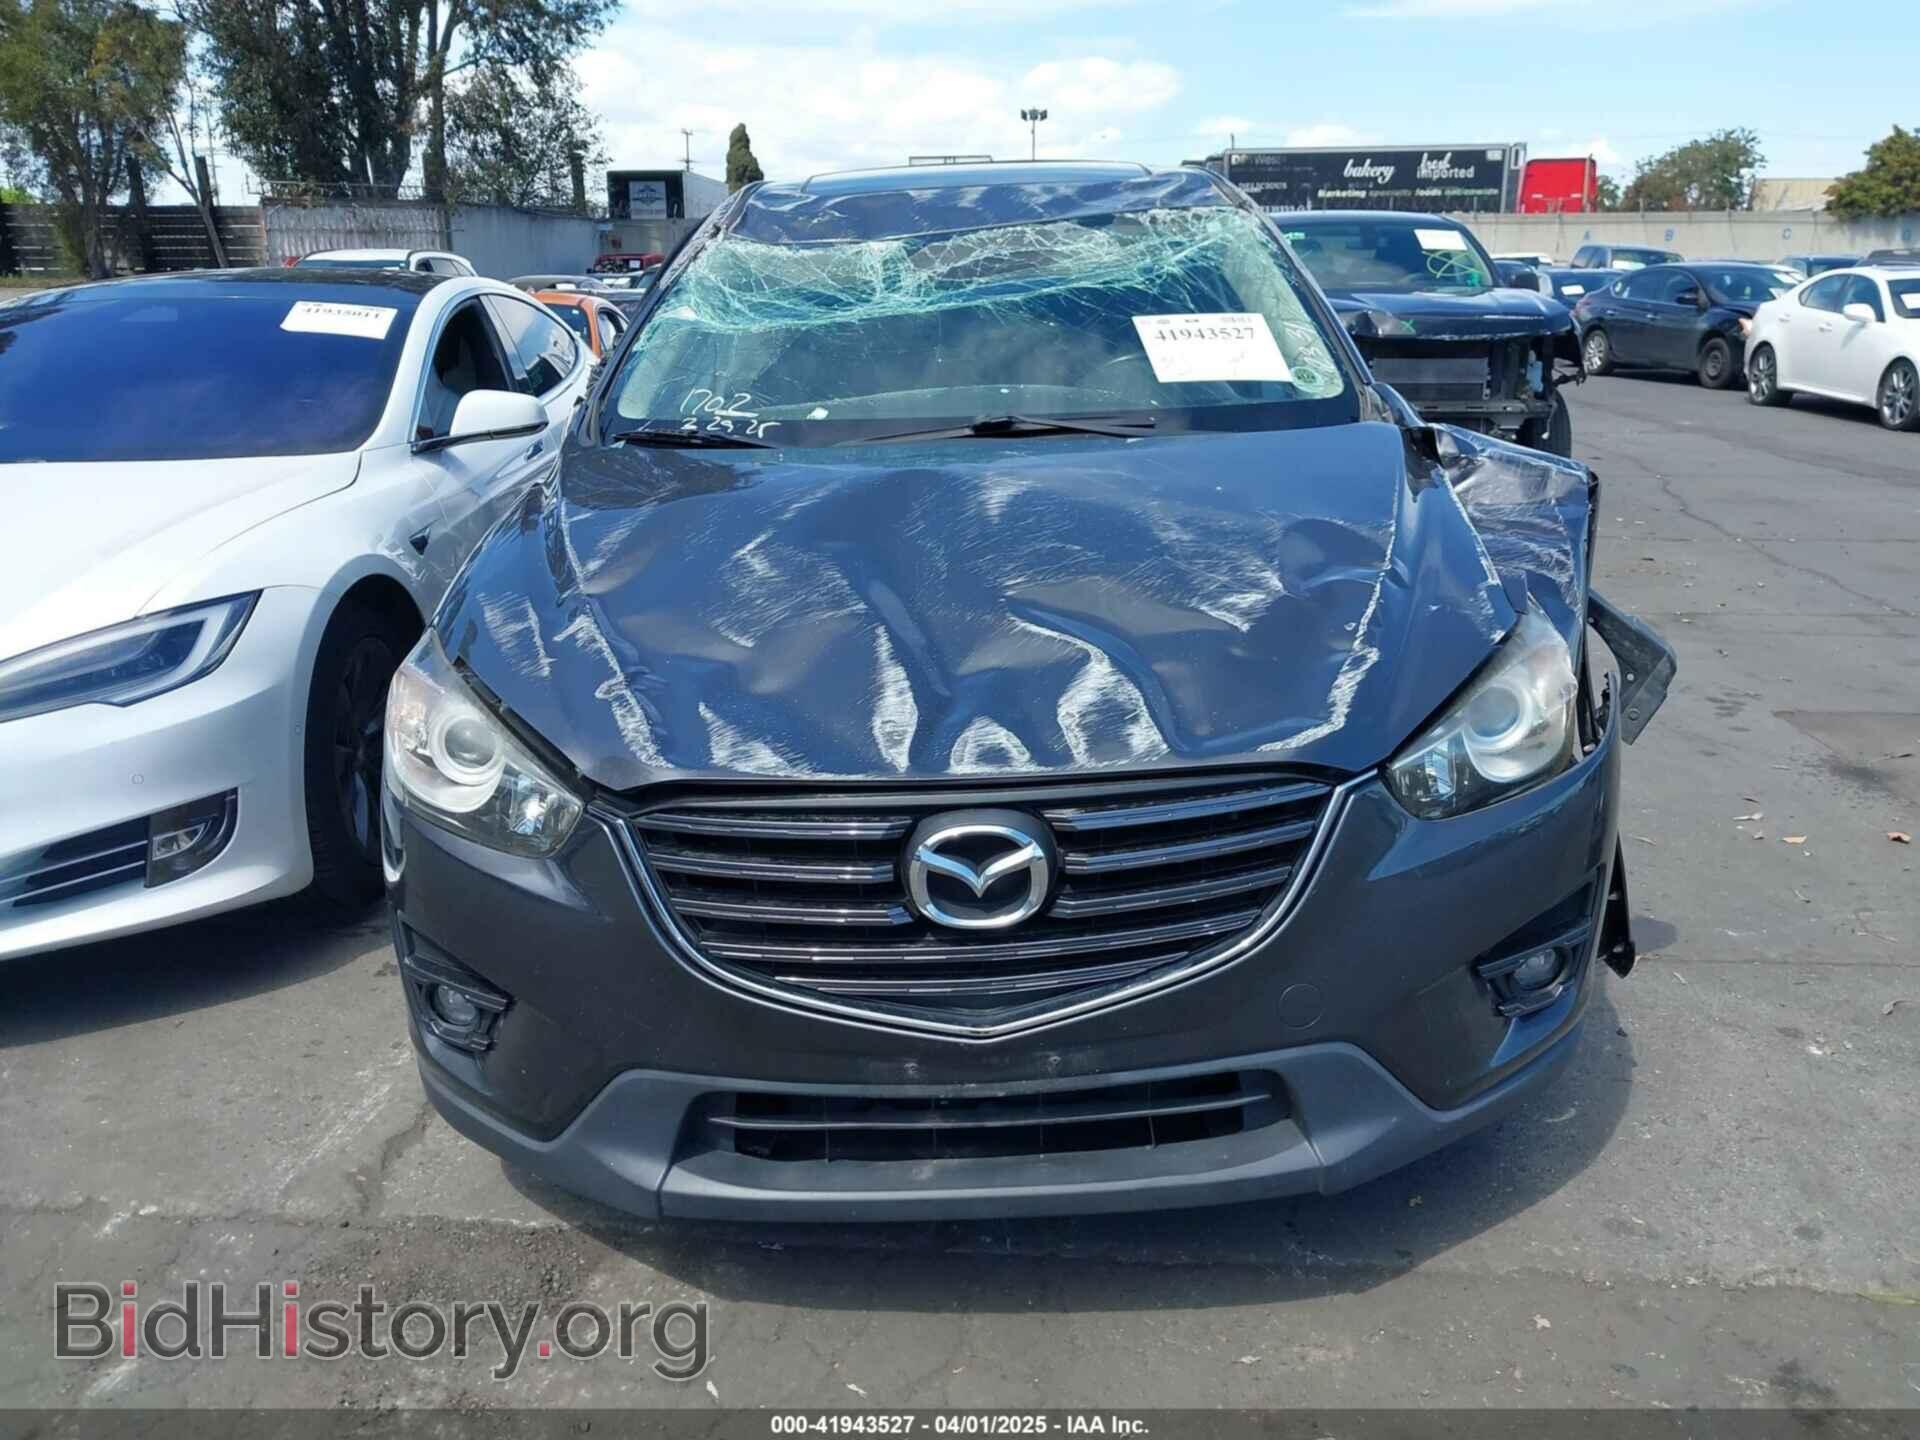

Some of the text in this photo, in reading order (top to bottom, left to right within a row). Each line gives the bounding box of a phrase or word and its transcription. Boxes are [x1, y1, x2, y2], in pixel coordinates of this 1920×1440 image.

[1343, 158, 1395, 184] bakery
[1416, 165, 1475, 181] imported
[1155, 327, 1254, 342] 41943527
